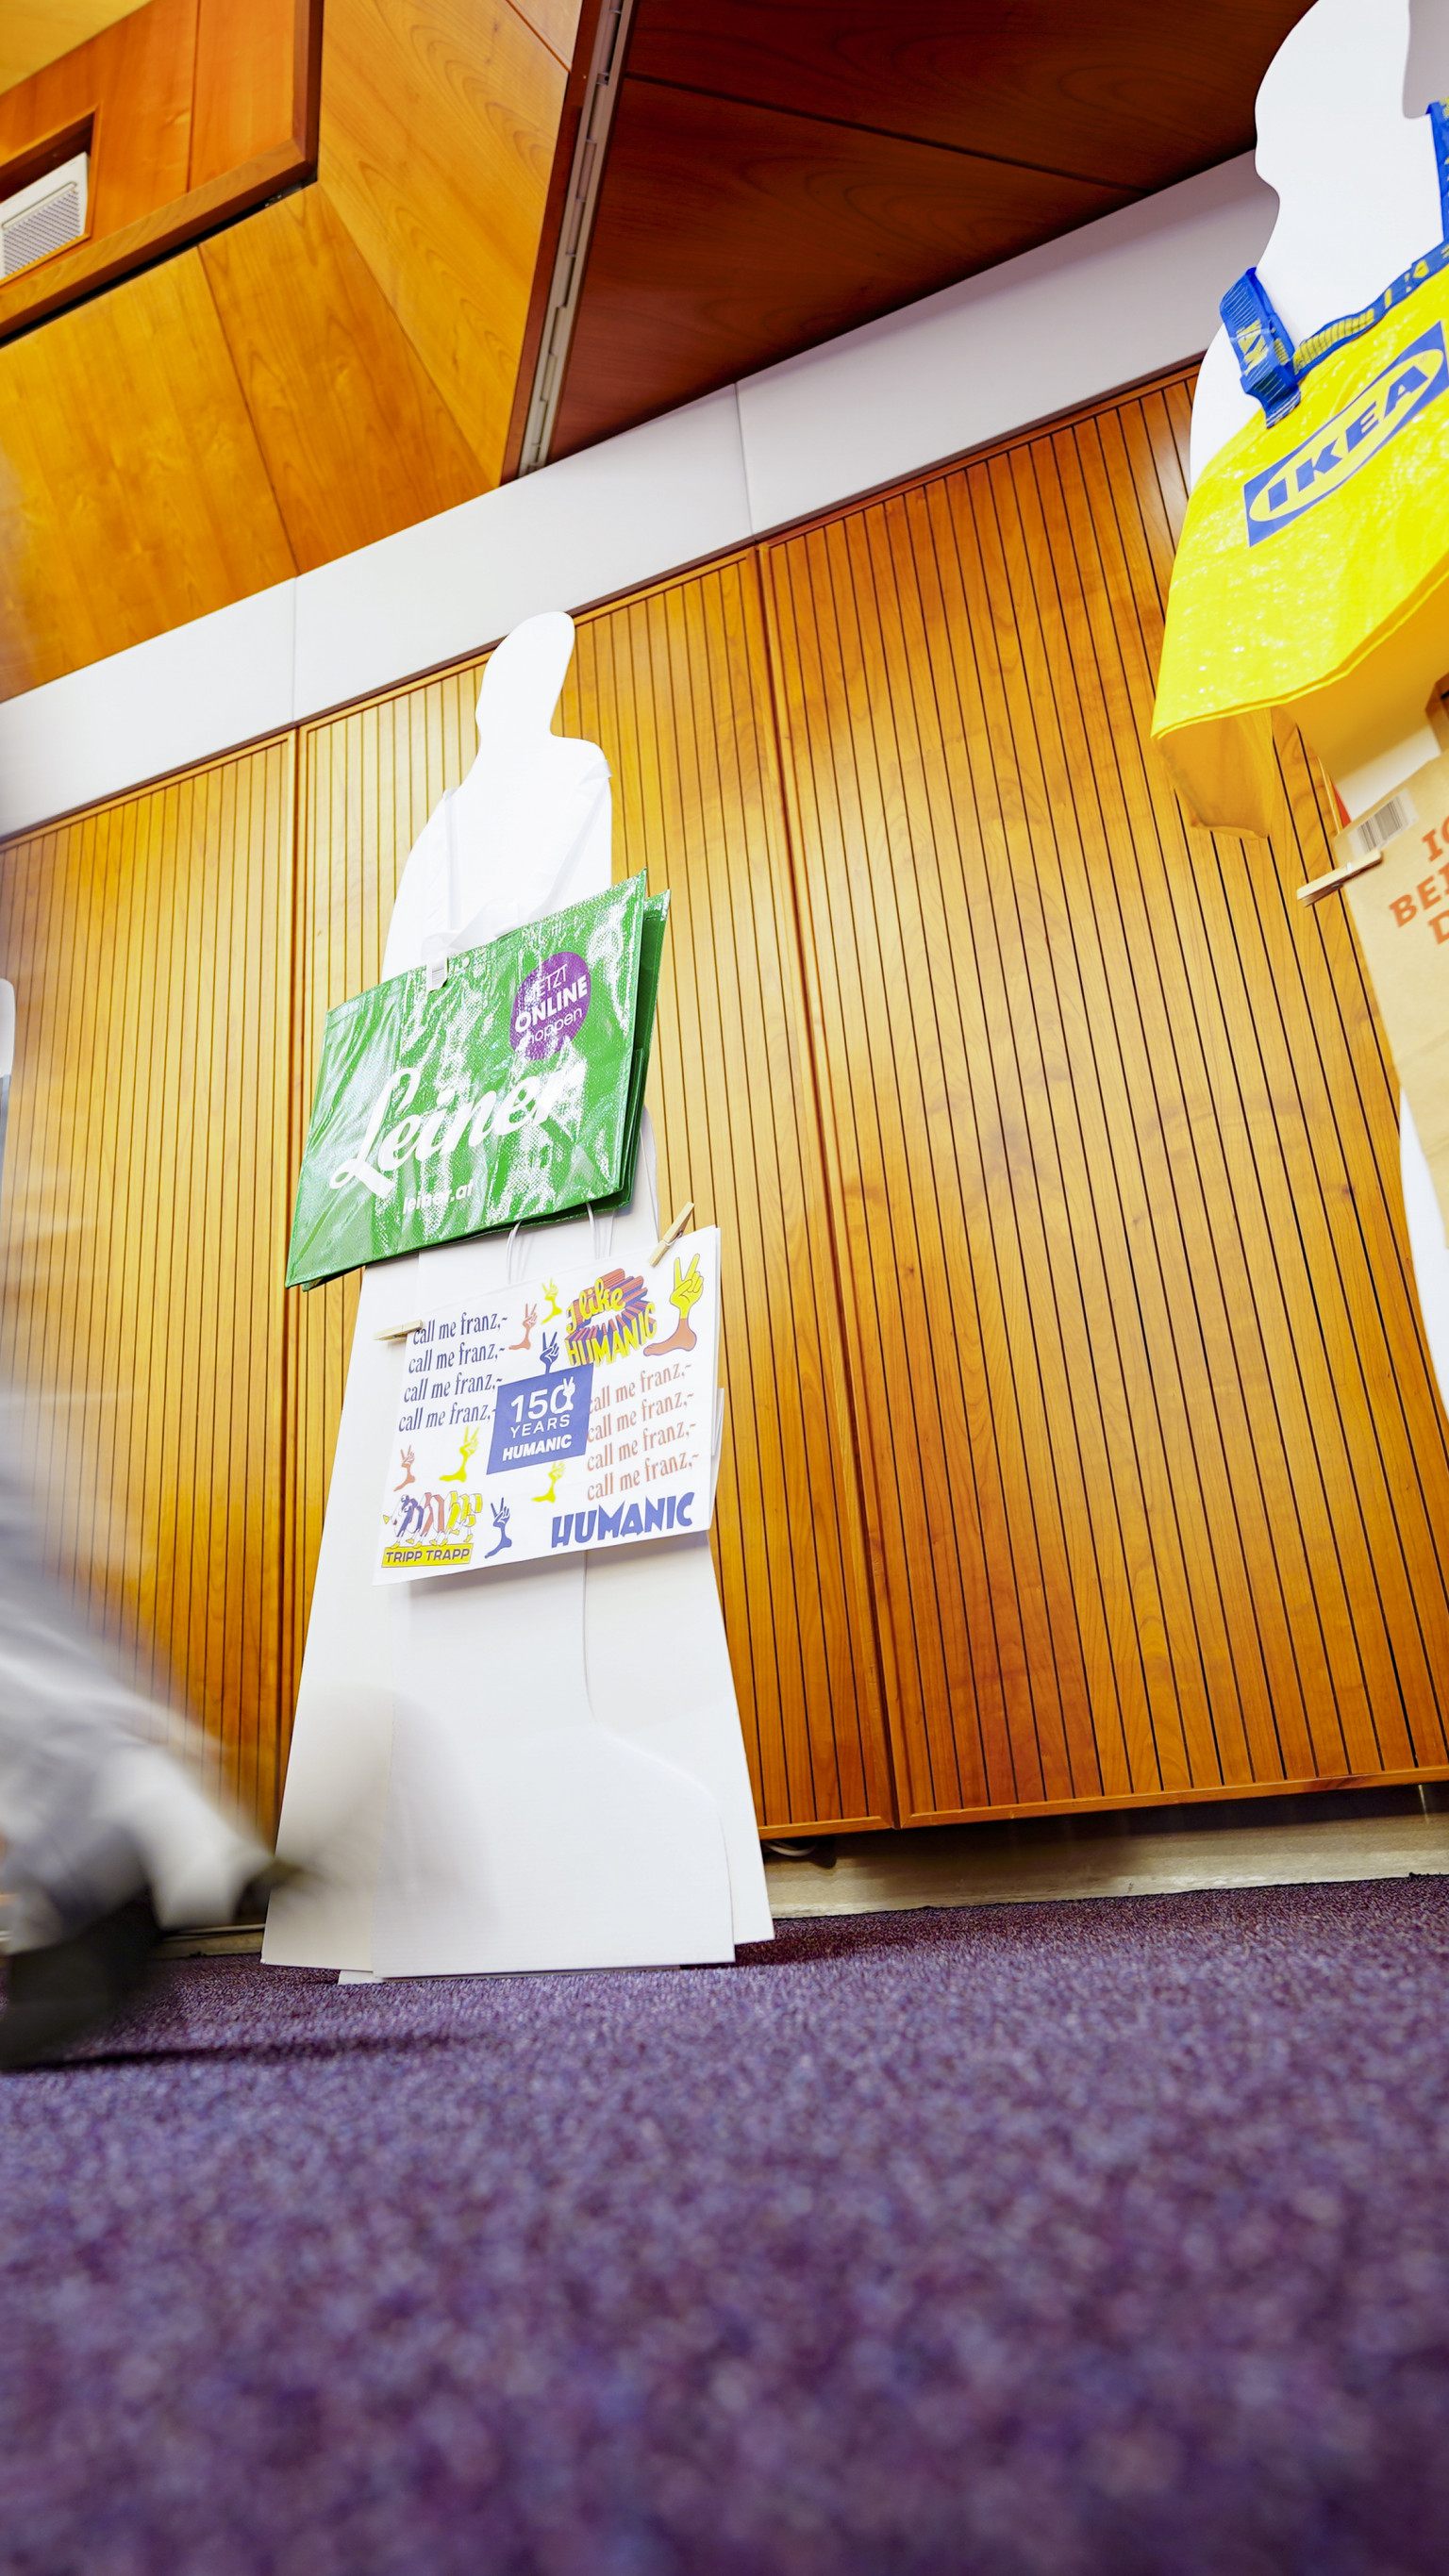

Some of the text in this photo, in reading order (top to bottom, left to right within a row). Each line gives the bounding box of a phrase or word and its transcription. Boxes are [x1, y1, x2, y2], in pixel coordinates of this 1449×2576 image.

[1268, 366, 1428, 512] IKEA
[515, 974, 588, 1033] ONLINE
[579, 1277, 626, 1319] like
[413, 1320, 435, 1345] call
[439, 1321, 456, 1339] me
[565, 1302, 658, 1367] HUMANIC
[408, 1349, 433, 1373] call
[436, 1351, 455, 1370] me
[404, 1377, 428, 1403] call
[431, 1381, 451, 1399] me
[510, 1382, 575, 1423] 150
[615, 1382, 636, 1404] me
[398, 1406, 424, 1432] call
[425, 1410, 446, 1428] me
[510, 1414, 570, 1438] YEARS
[587, 1413, 612, 1443] call
[617, 1410, 637, 1432] me
[502, 1434, 573, 1461] HUMANIC
[587, 1442, 613, 1471] call
[619, 1439, 639, 1461] me
[587, 1472, 614, 1501] call
[620, 1470, 641, 1491] me
[552, 1492, 695, 1549] HUMANIC
[386, 1548, 470, 1563] TRIPP TRAPP
